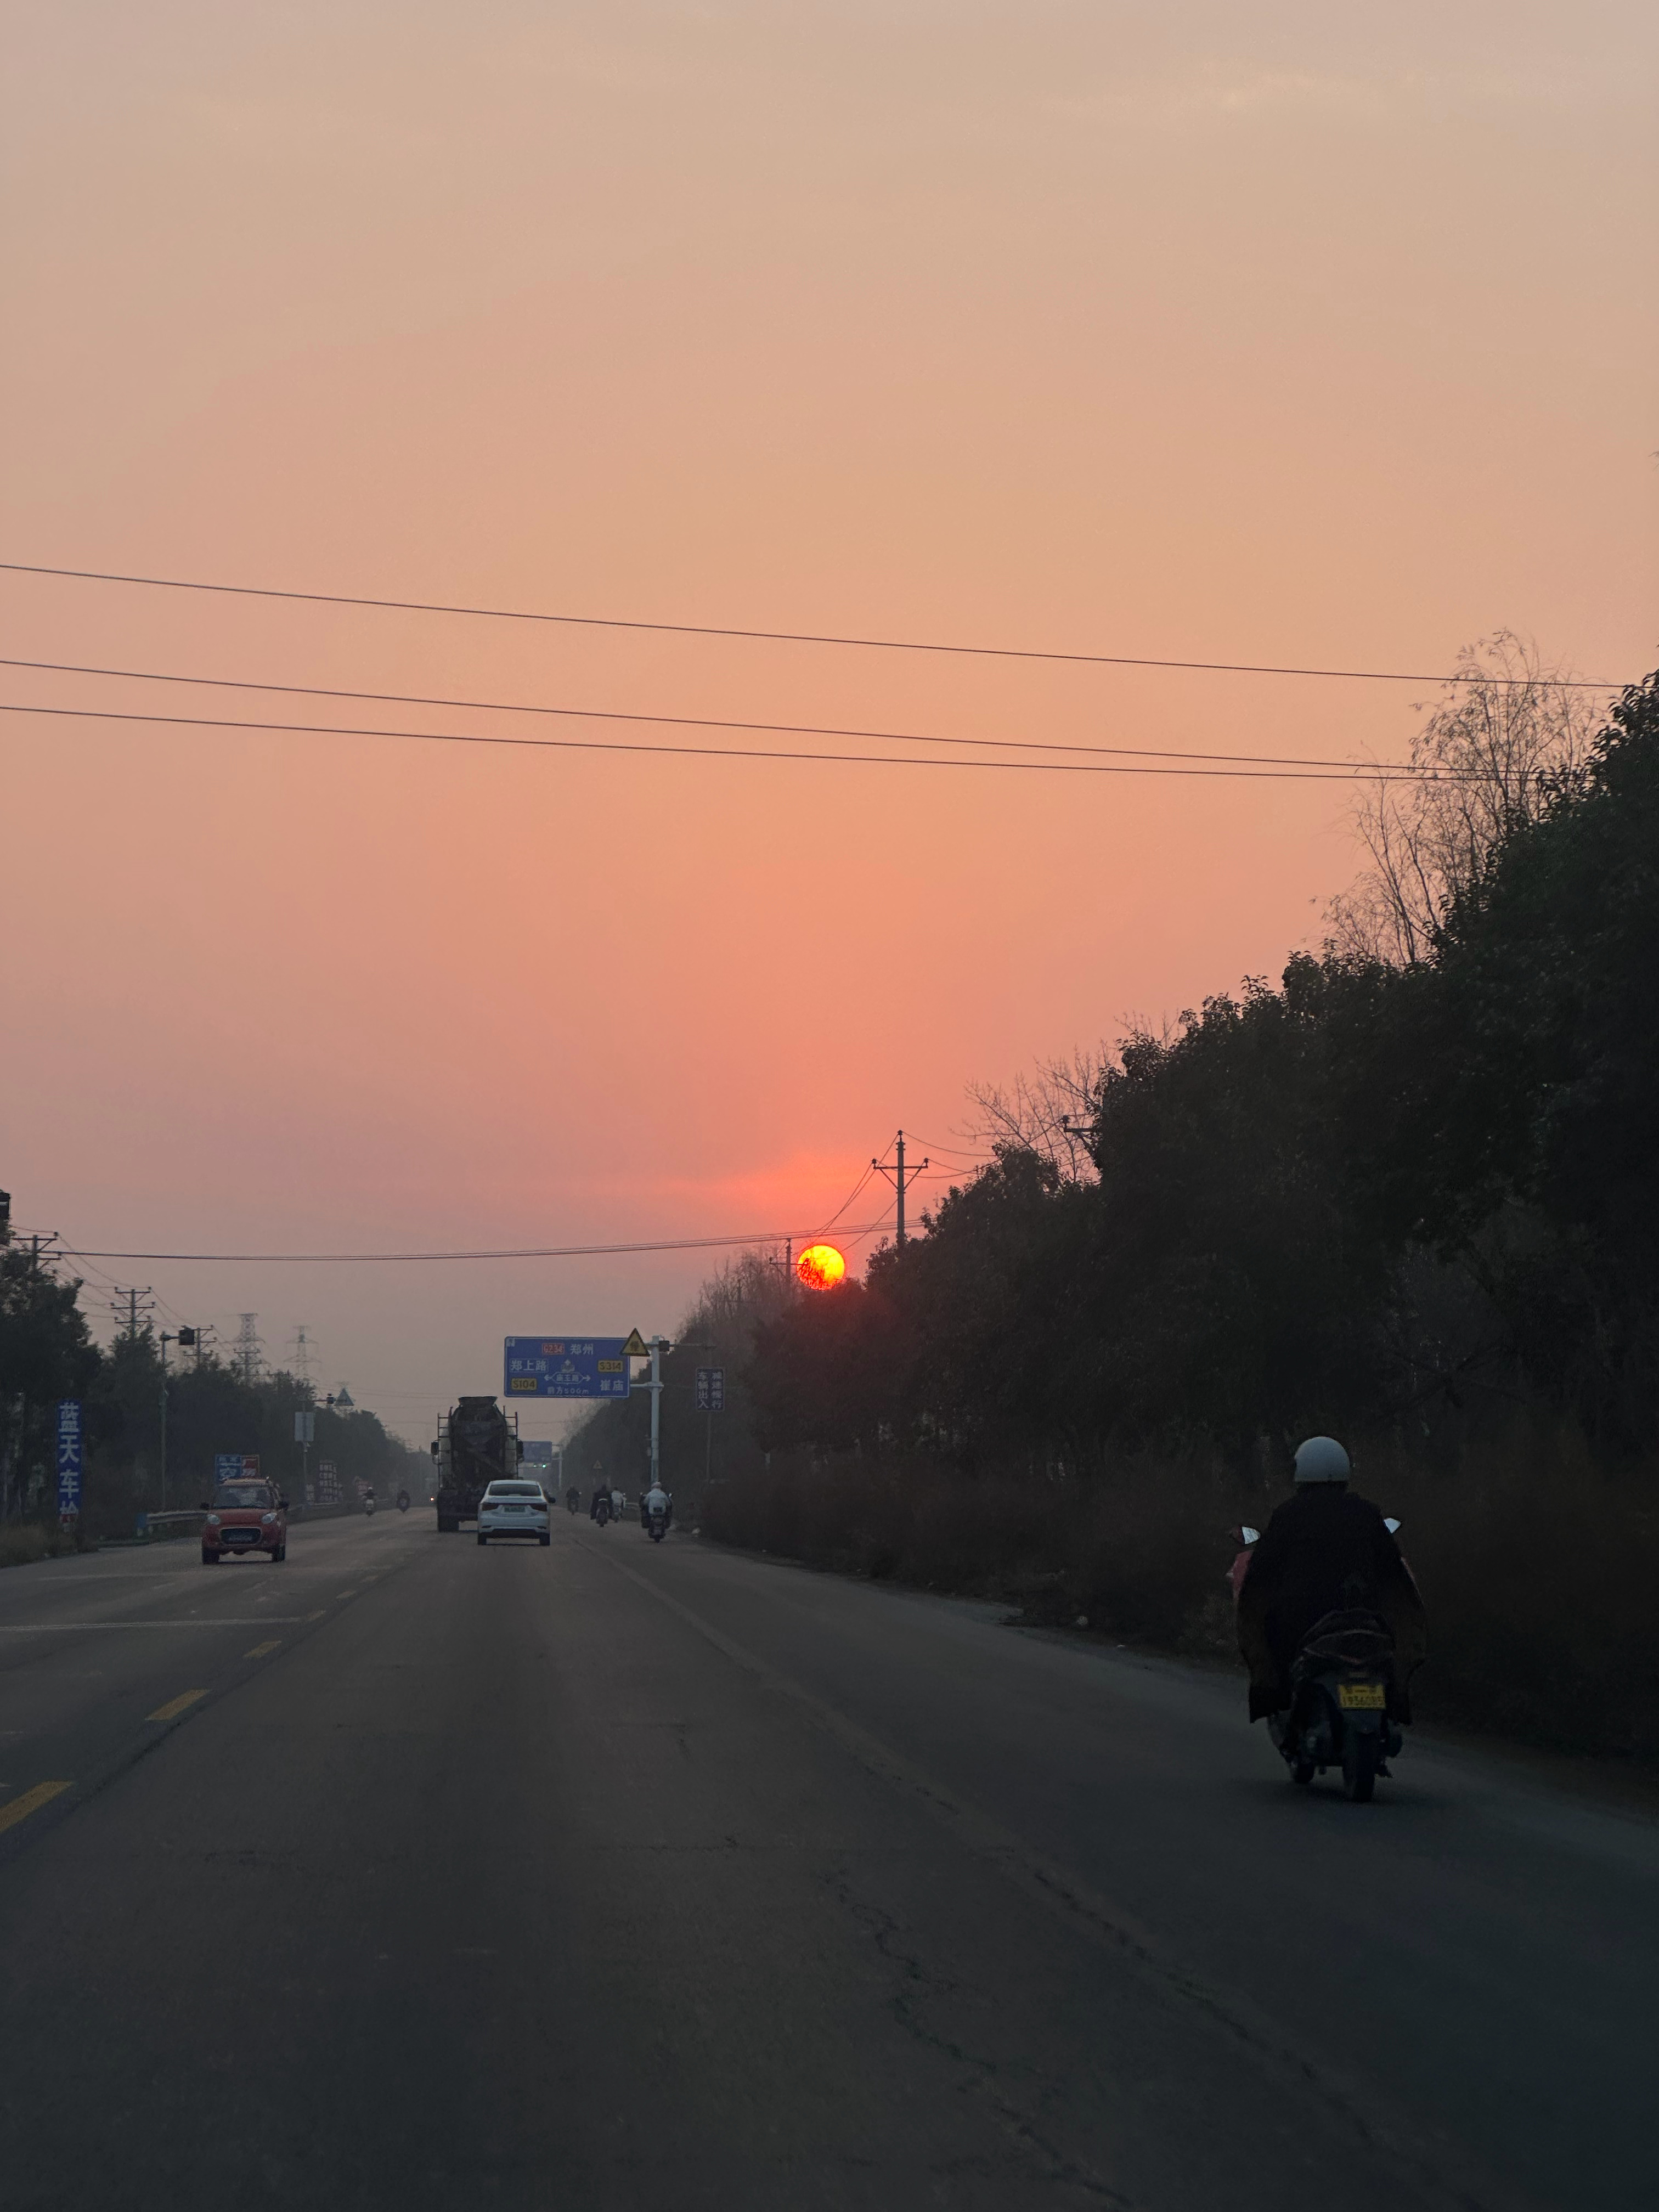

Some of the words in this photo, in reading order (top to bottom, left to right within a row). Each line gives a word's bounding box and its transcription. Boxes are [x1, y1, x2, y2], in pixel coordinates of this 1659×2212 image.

[544, 1345, 563, 1353] G234
[571, 1344, 594, 1355] 郑州
[511, 1360, 546, 1371] 郑上路
[513, 1380, 535, 1389] S104
[600, 1380, 623, 1391] 崔庙
